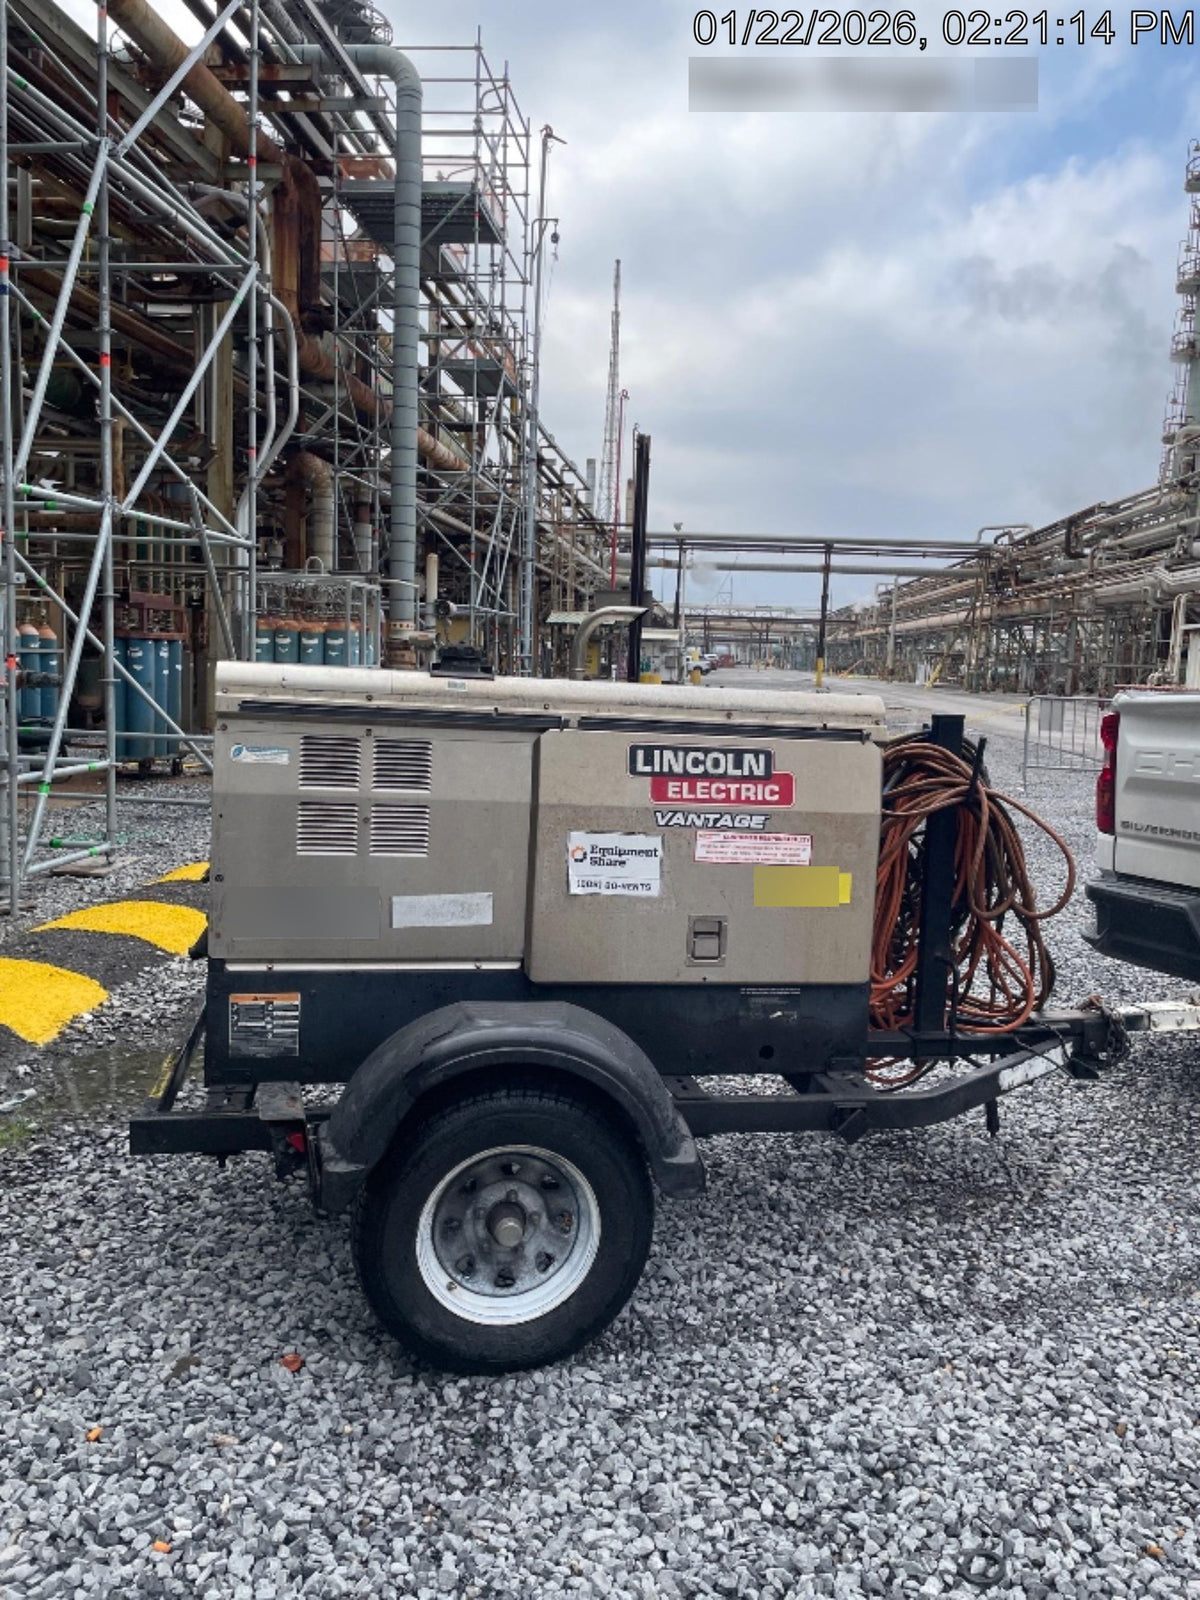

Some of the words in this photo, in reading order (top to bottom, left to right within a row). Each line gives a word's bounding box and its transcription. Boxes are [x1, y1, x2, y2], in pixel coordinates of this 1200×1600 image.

[636, 749, 766, 776] LINCOLN
[667, 781, 780, 801] ELECTRIC
[654, 811, 769, 830] VANTAGE
[589, 844, 659, 858] Equipment
[589, 856, 627, 867] Share
